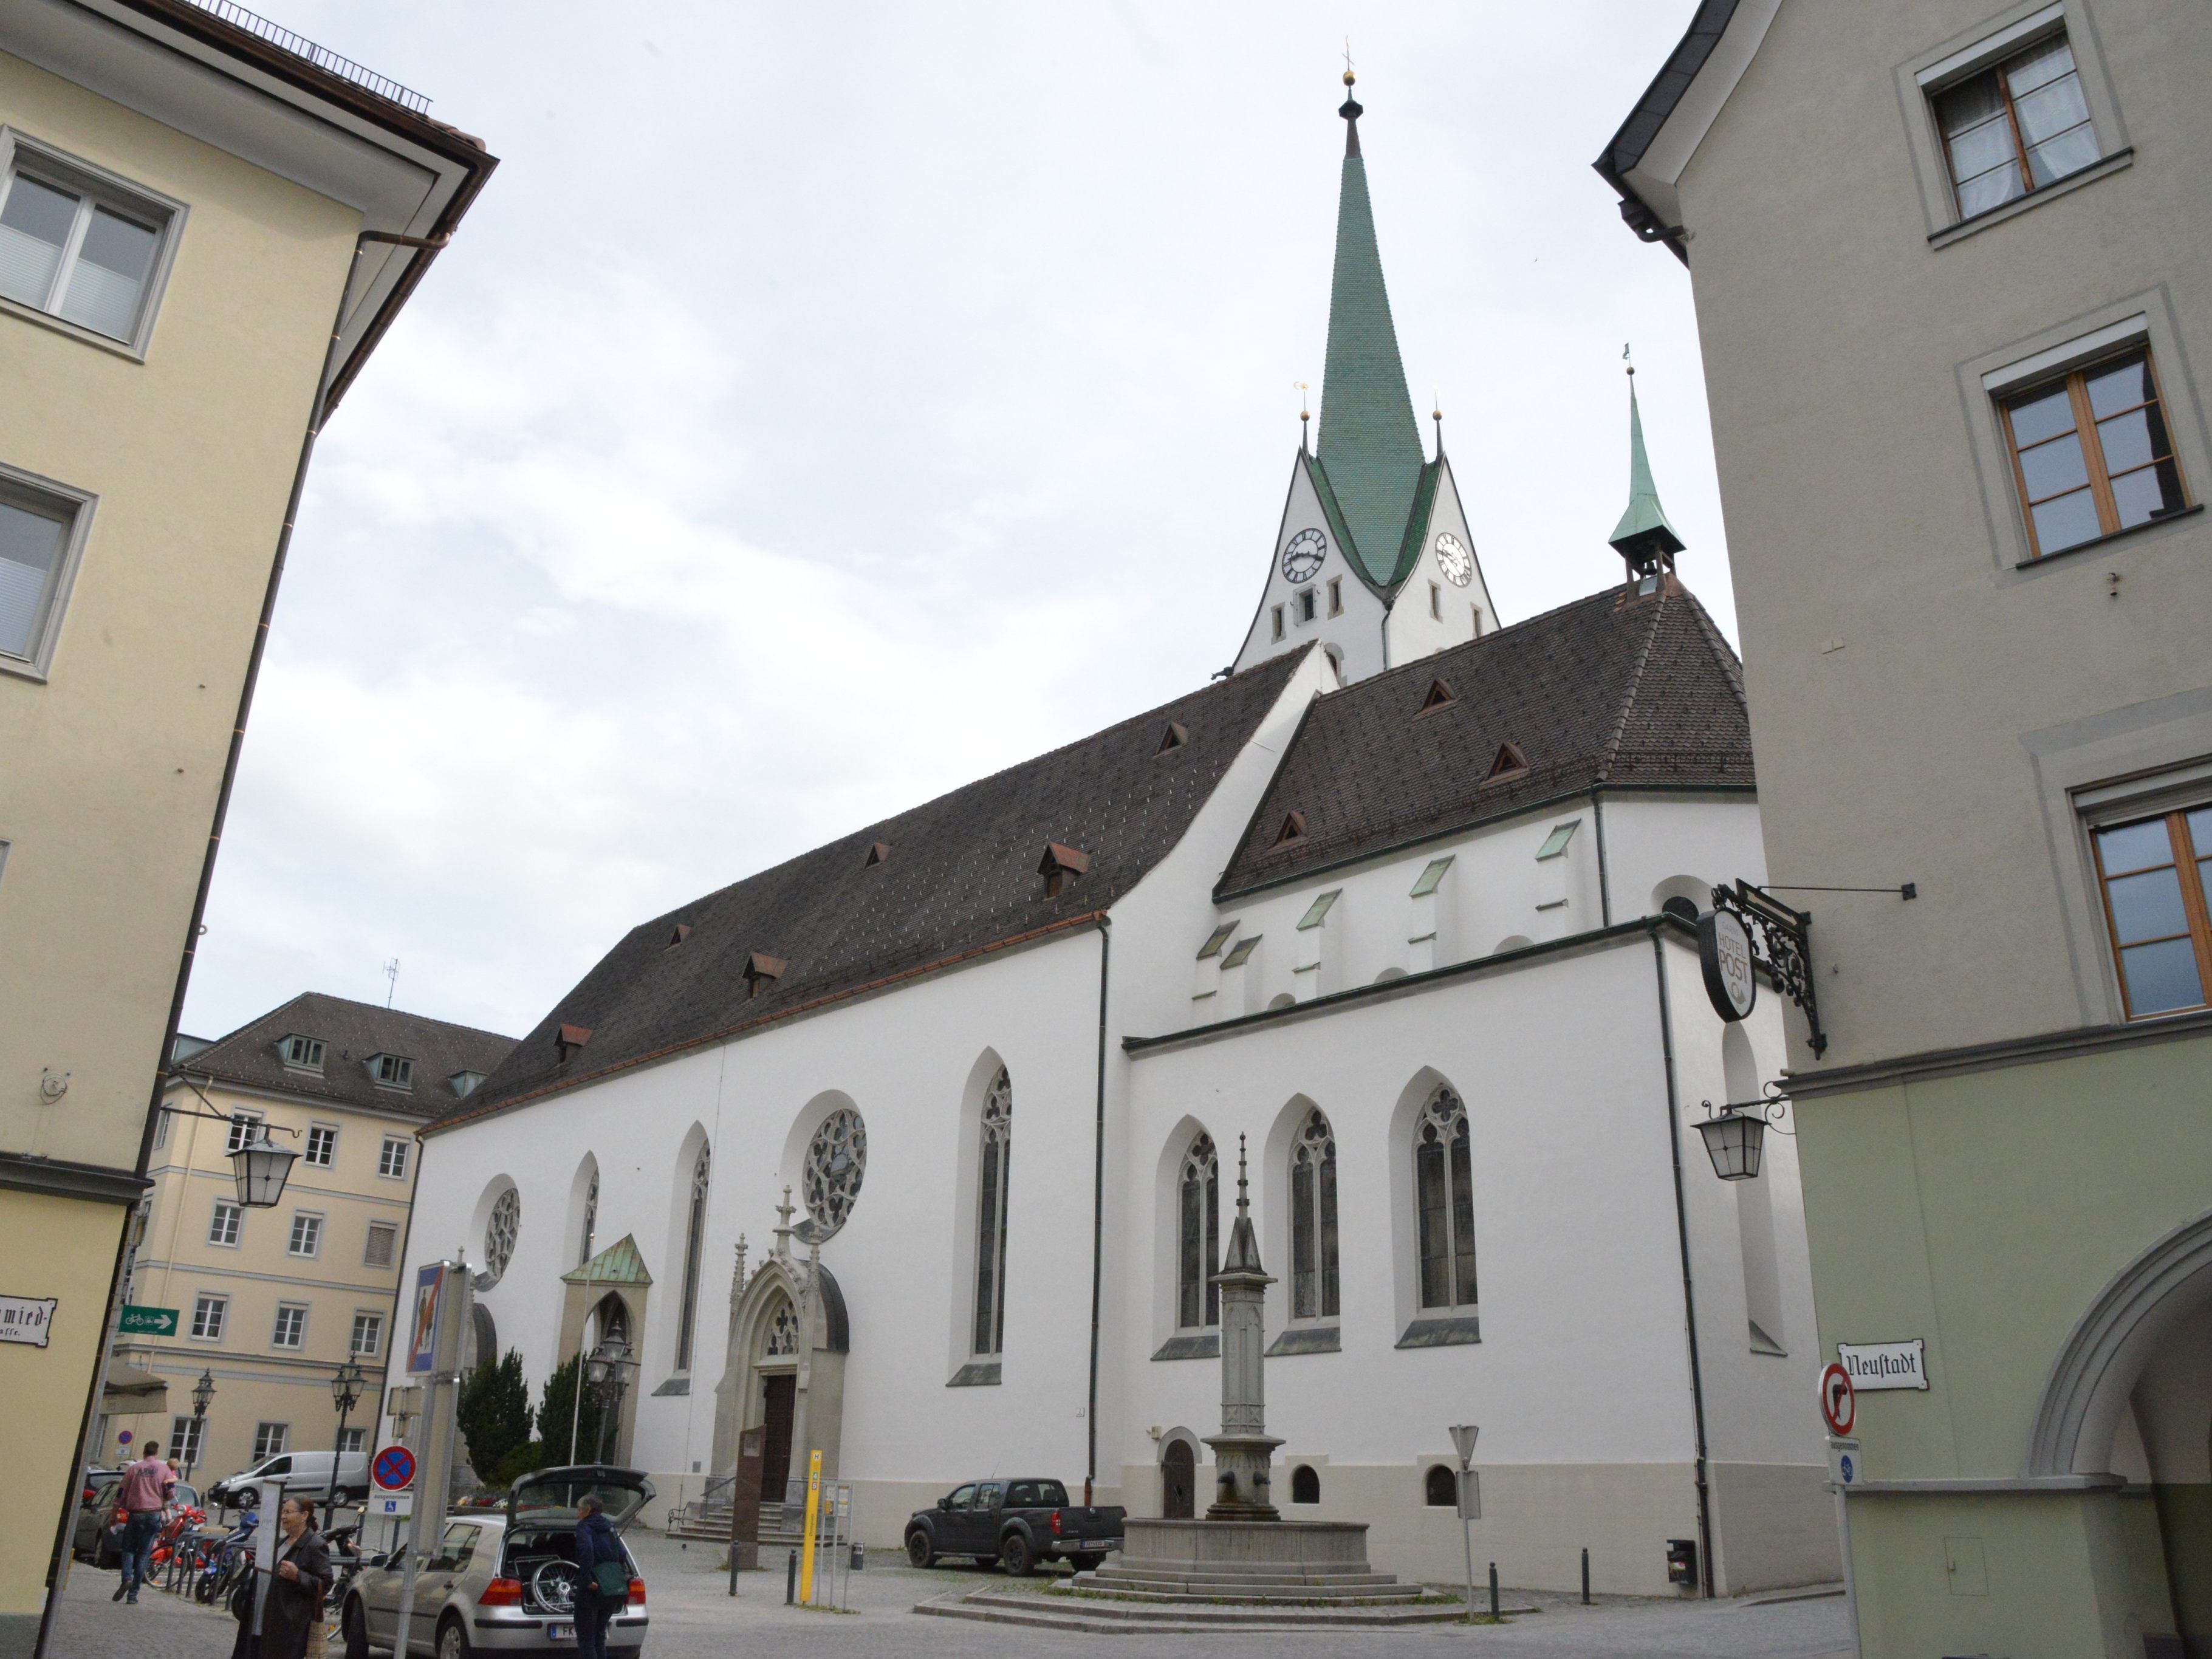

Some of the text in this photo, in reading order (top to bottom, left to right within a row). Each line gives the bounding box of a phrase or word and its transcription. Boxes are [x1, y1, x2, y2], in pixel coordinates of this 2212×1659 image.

[1719, 932, 1745, 959] HOTEL
[1719, 948, 1747, 984] POST
[0, 1305, 47, 1325] mied-
[1846, 1353, 1917, 1378] Neustadt
